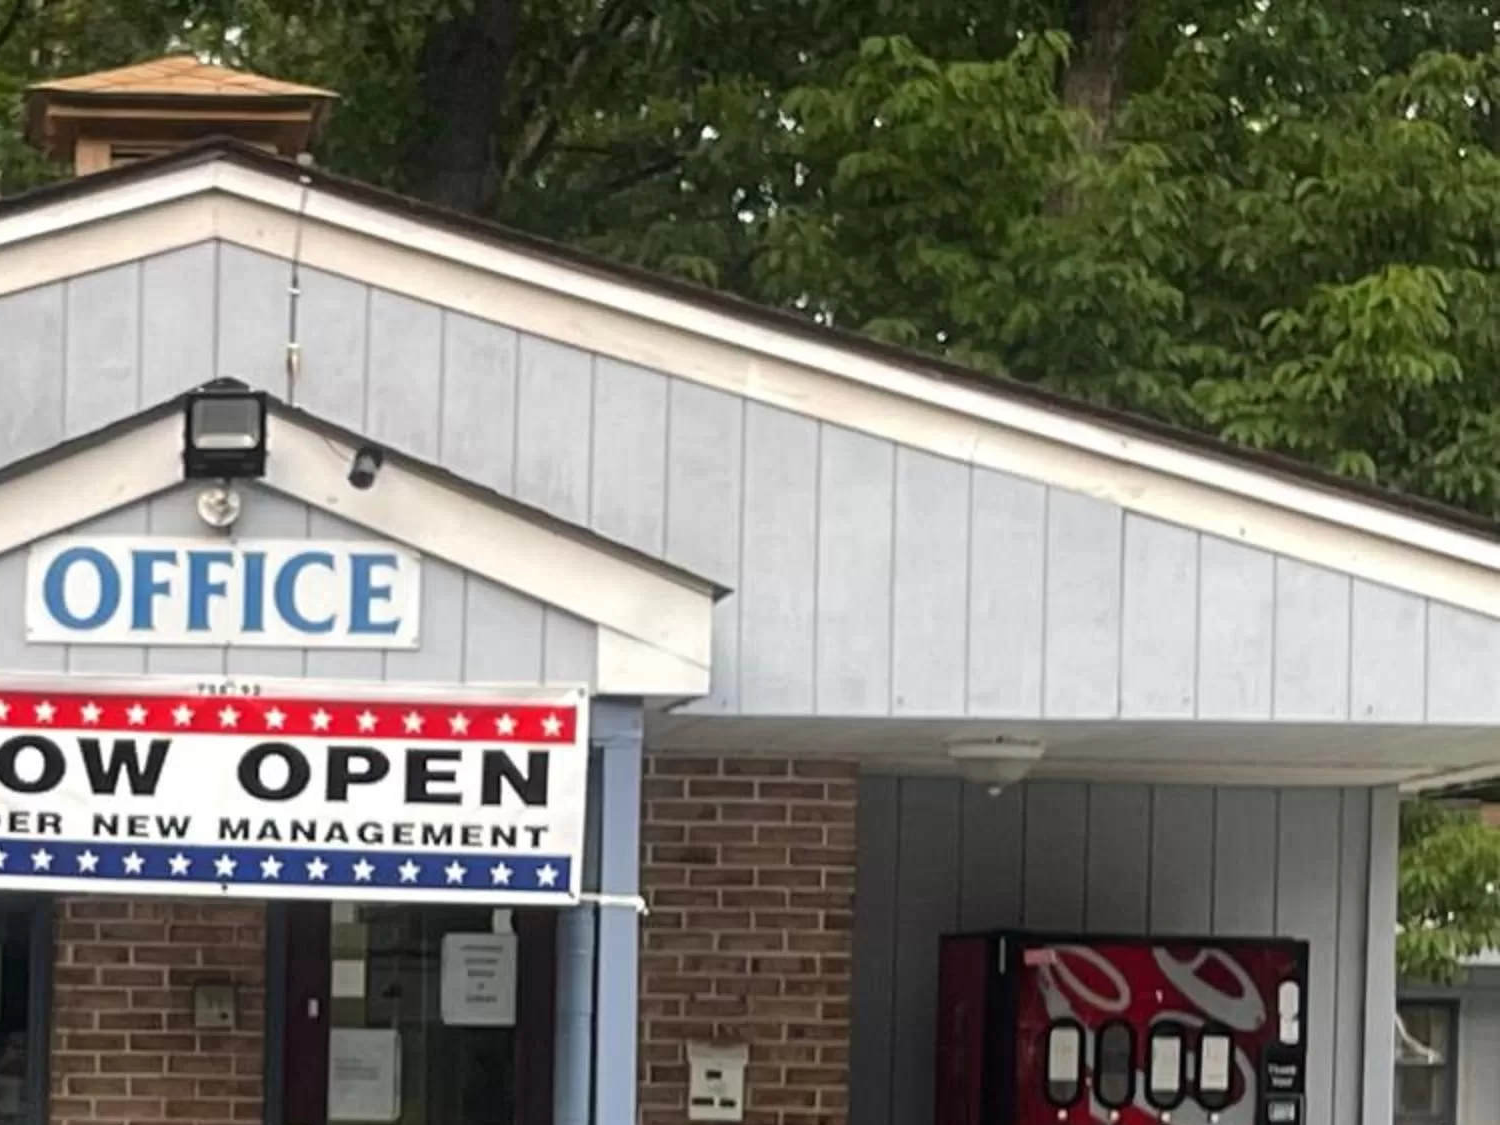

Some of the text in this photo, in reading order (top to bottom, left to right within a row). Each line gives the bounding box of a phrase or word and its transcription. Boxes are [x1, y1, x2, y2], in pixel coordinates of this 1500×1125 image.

[42, 546, 401, 634] OFFICE
[237, 742, 550, 806] OPEN
[93, 814, 192, 840] NEW
[216, 817, 549, 849] MANAGEMENT
